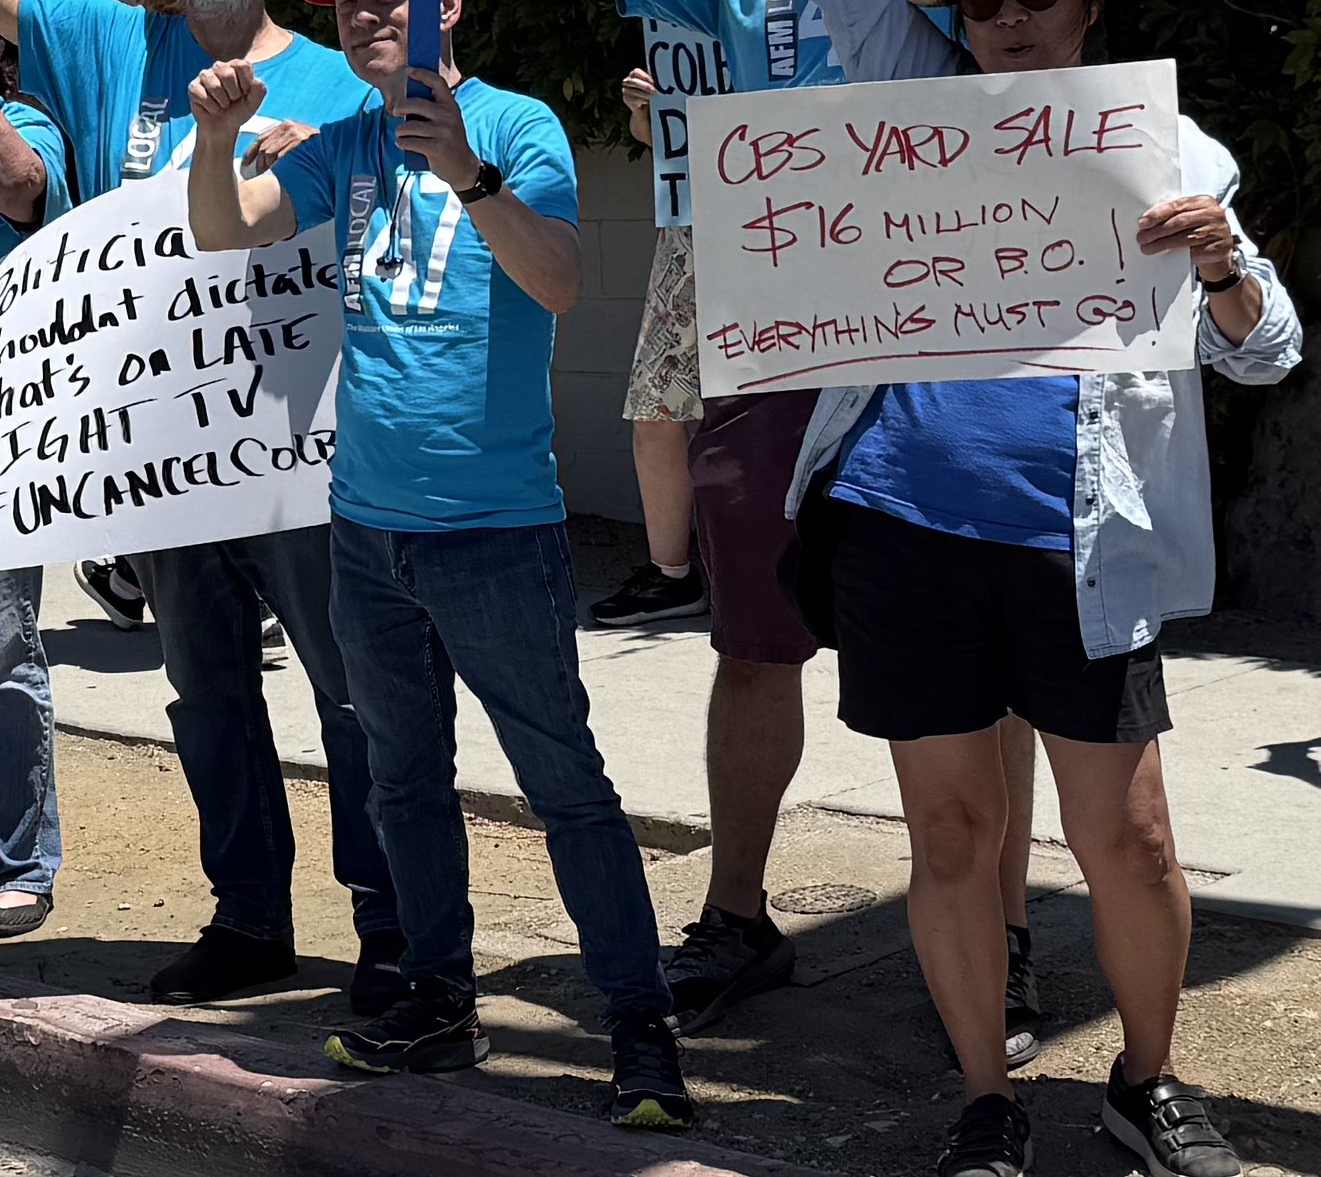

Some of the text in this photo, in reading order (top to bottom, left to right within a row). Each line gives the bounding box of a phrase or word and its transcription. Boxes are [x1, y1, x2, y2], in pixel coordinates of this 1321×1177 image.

[768, 20, 795, 78] AFM
[124, 98, 169, 172] LOCAL
[718, 104, 1145, 185] CBS YARD SALE
[343, 176, 377, 312] AFM LOCAL
[362, 172, 463, 316] 47
[741, 195, 1060, 268] $16 MILLION
[167, 248, 340, 322] dictate
[883, 256, 965, 288] OR
[118, 349, 170, 387] on
[192, 313, 319, 371] LATE
[707, 303, 937, 361] EVERYTHING
[955, 299, 1060, 333] MUST
[172, 364, 264, 428] TV
